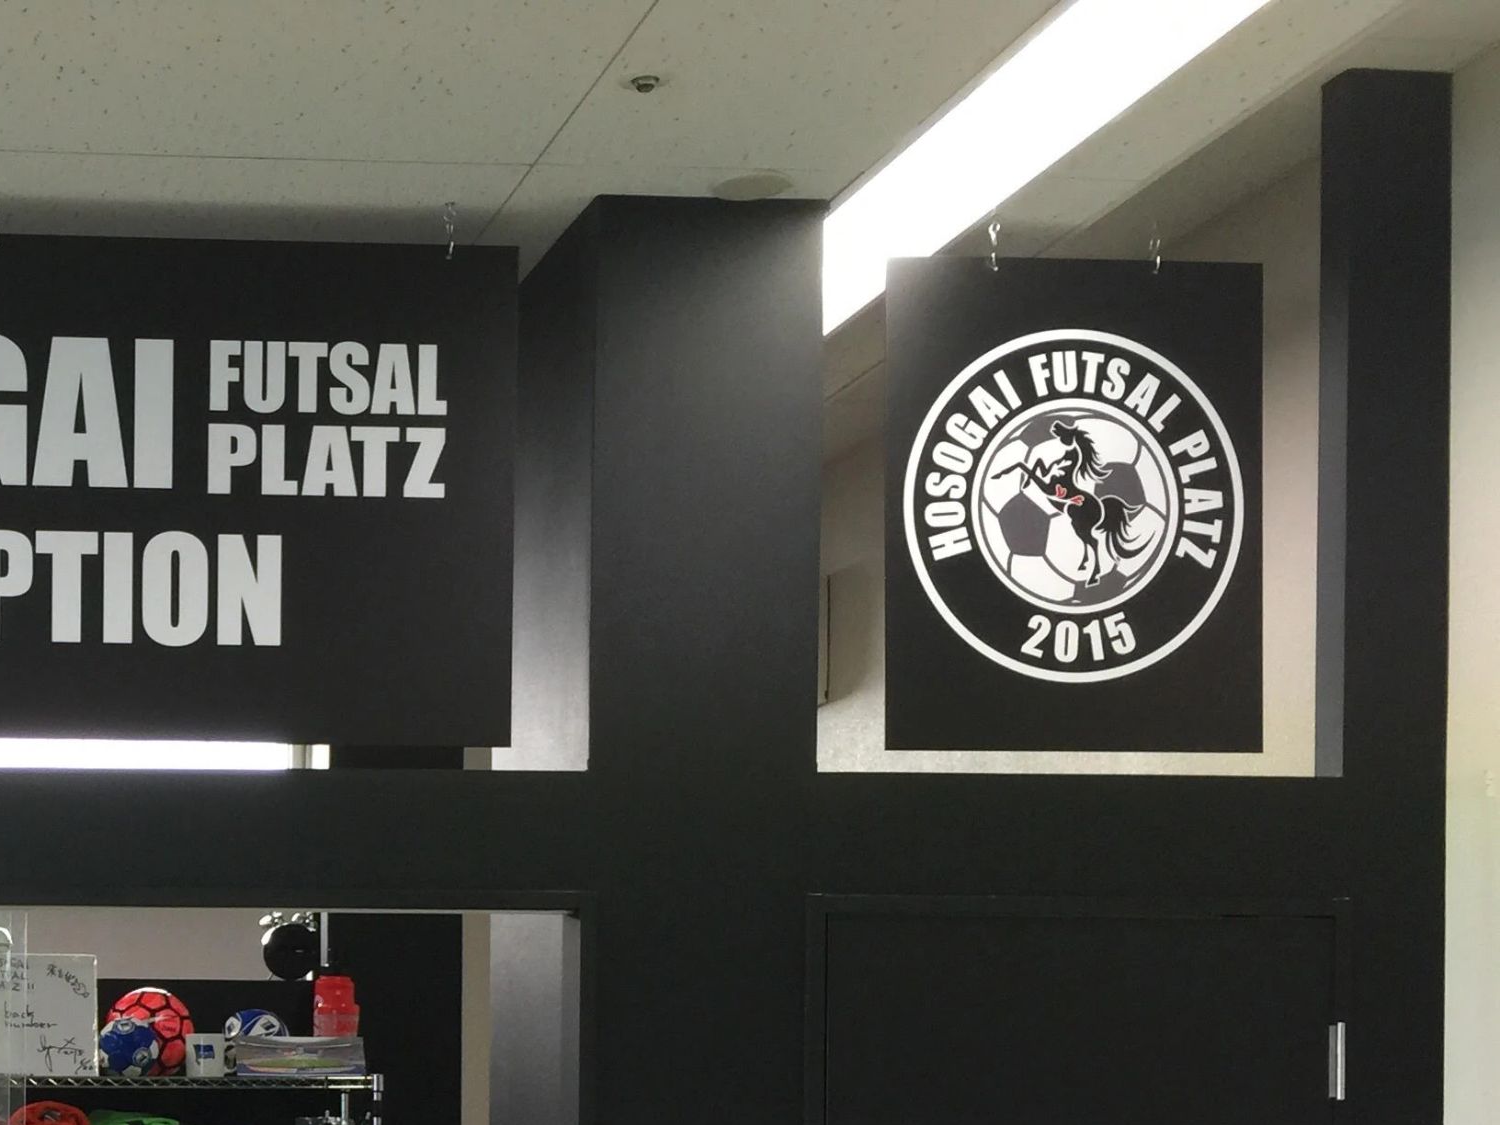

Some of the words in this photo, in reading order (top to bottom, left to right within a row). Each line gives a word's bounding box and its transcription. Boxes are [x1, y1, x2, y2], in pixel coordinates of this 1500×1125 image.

[208, 339, 448, 417] FUTSAL
[206, 422, 446, 499] PLATZ
[924, 369, 1023, 562] HOSOGAI
[1028, 349, 1183, 433] FUTSAL
[1169, 428, 1224, 570] PLATZ
[1020, 611, 1137, 664] 2015
